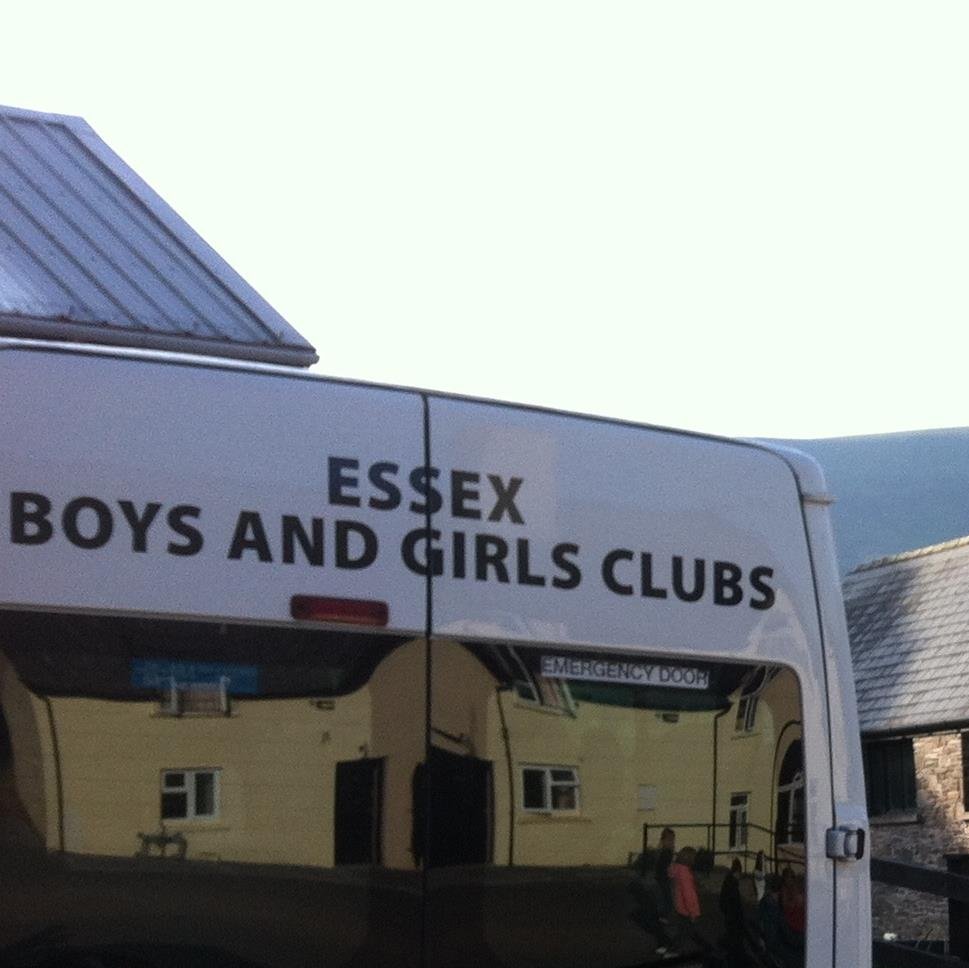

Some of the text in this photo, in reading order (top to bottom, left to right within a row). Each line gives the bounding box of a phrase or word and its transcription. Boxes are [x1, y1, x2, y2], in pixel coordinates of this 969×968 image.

[327, 456, 525, 525] ESSEX
[10, 491, 777, 611] BOYS AND GIRLS CLUBS
[543, 656, 708, 688] EMERGENCY DOOR
